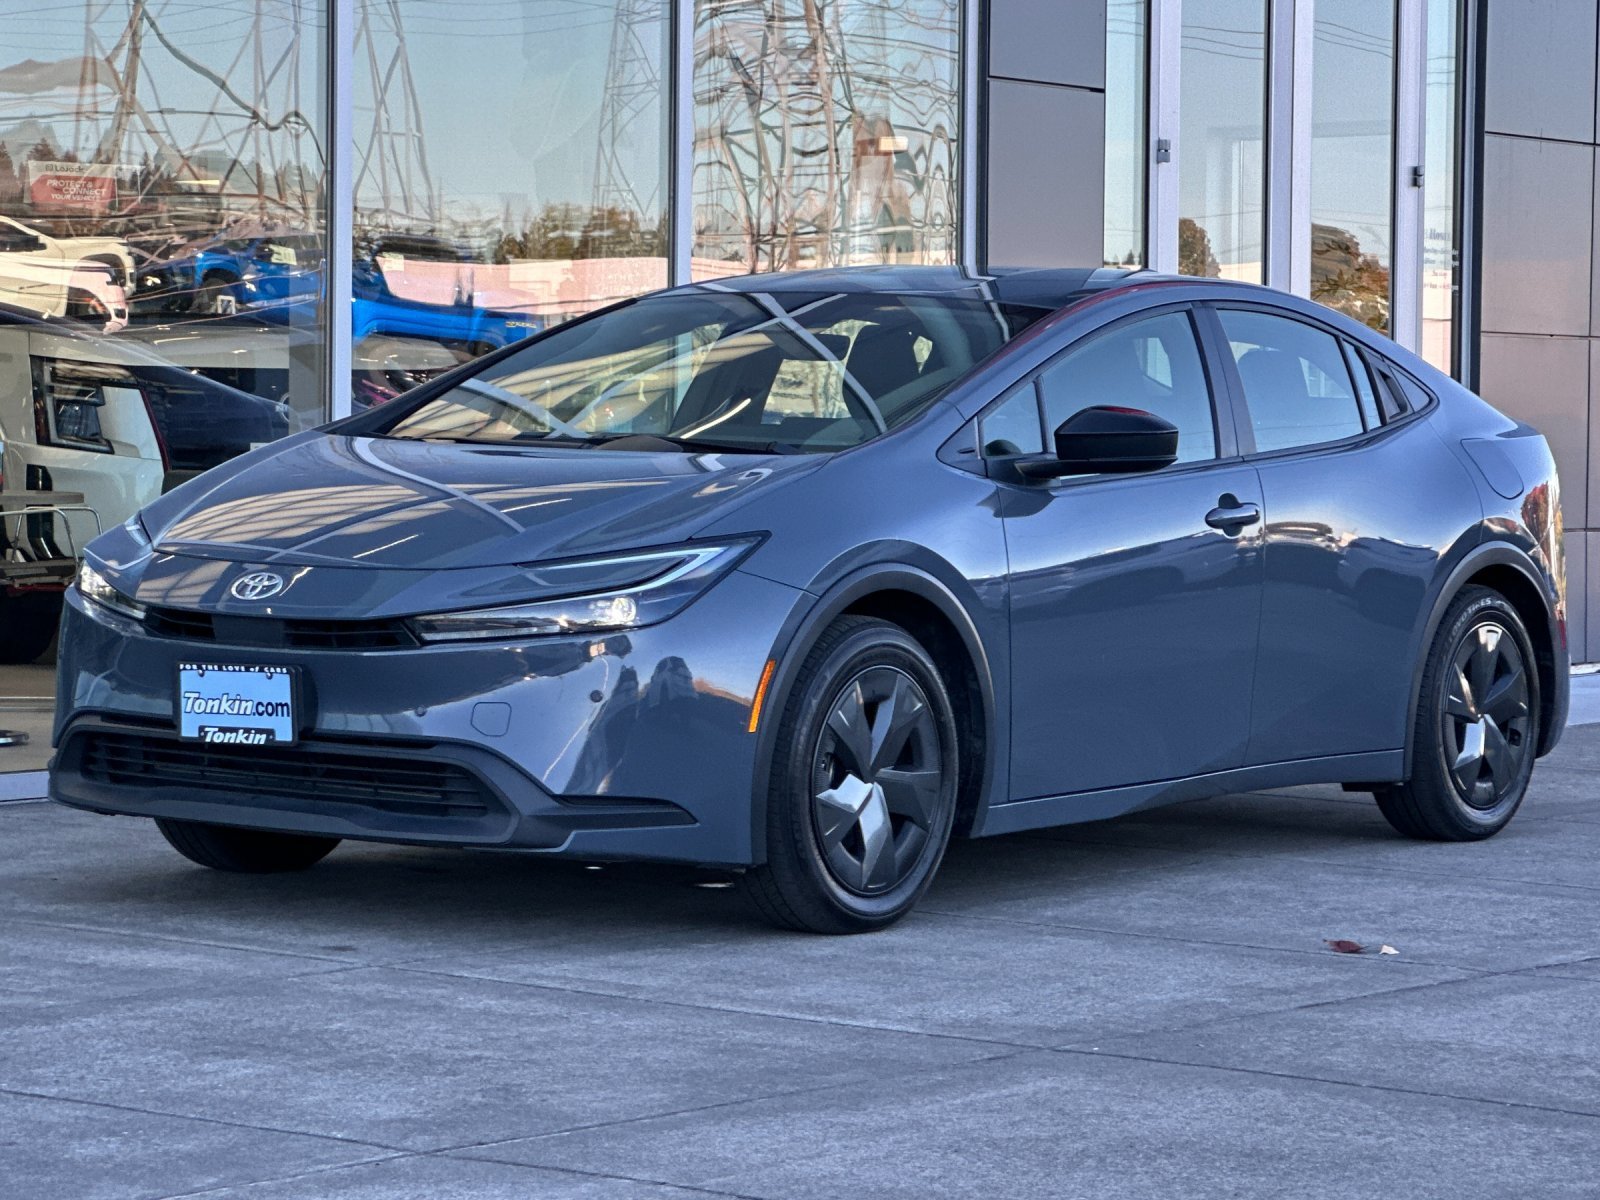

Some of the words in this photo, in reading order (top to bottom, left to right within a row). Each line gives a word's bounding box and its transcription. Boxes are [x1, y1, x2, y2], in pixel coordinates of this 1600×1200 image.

[46, 179, 86, 188] PROTECT
[62, 187, 107, 196] CONNECT
[184, 691, 290, 717] Tonkin.com
[203, 727, 267, 744] Tonkin
